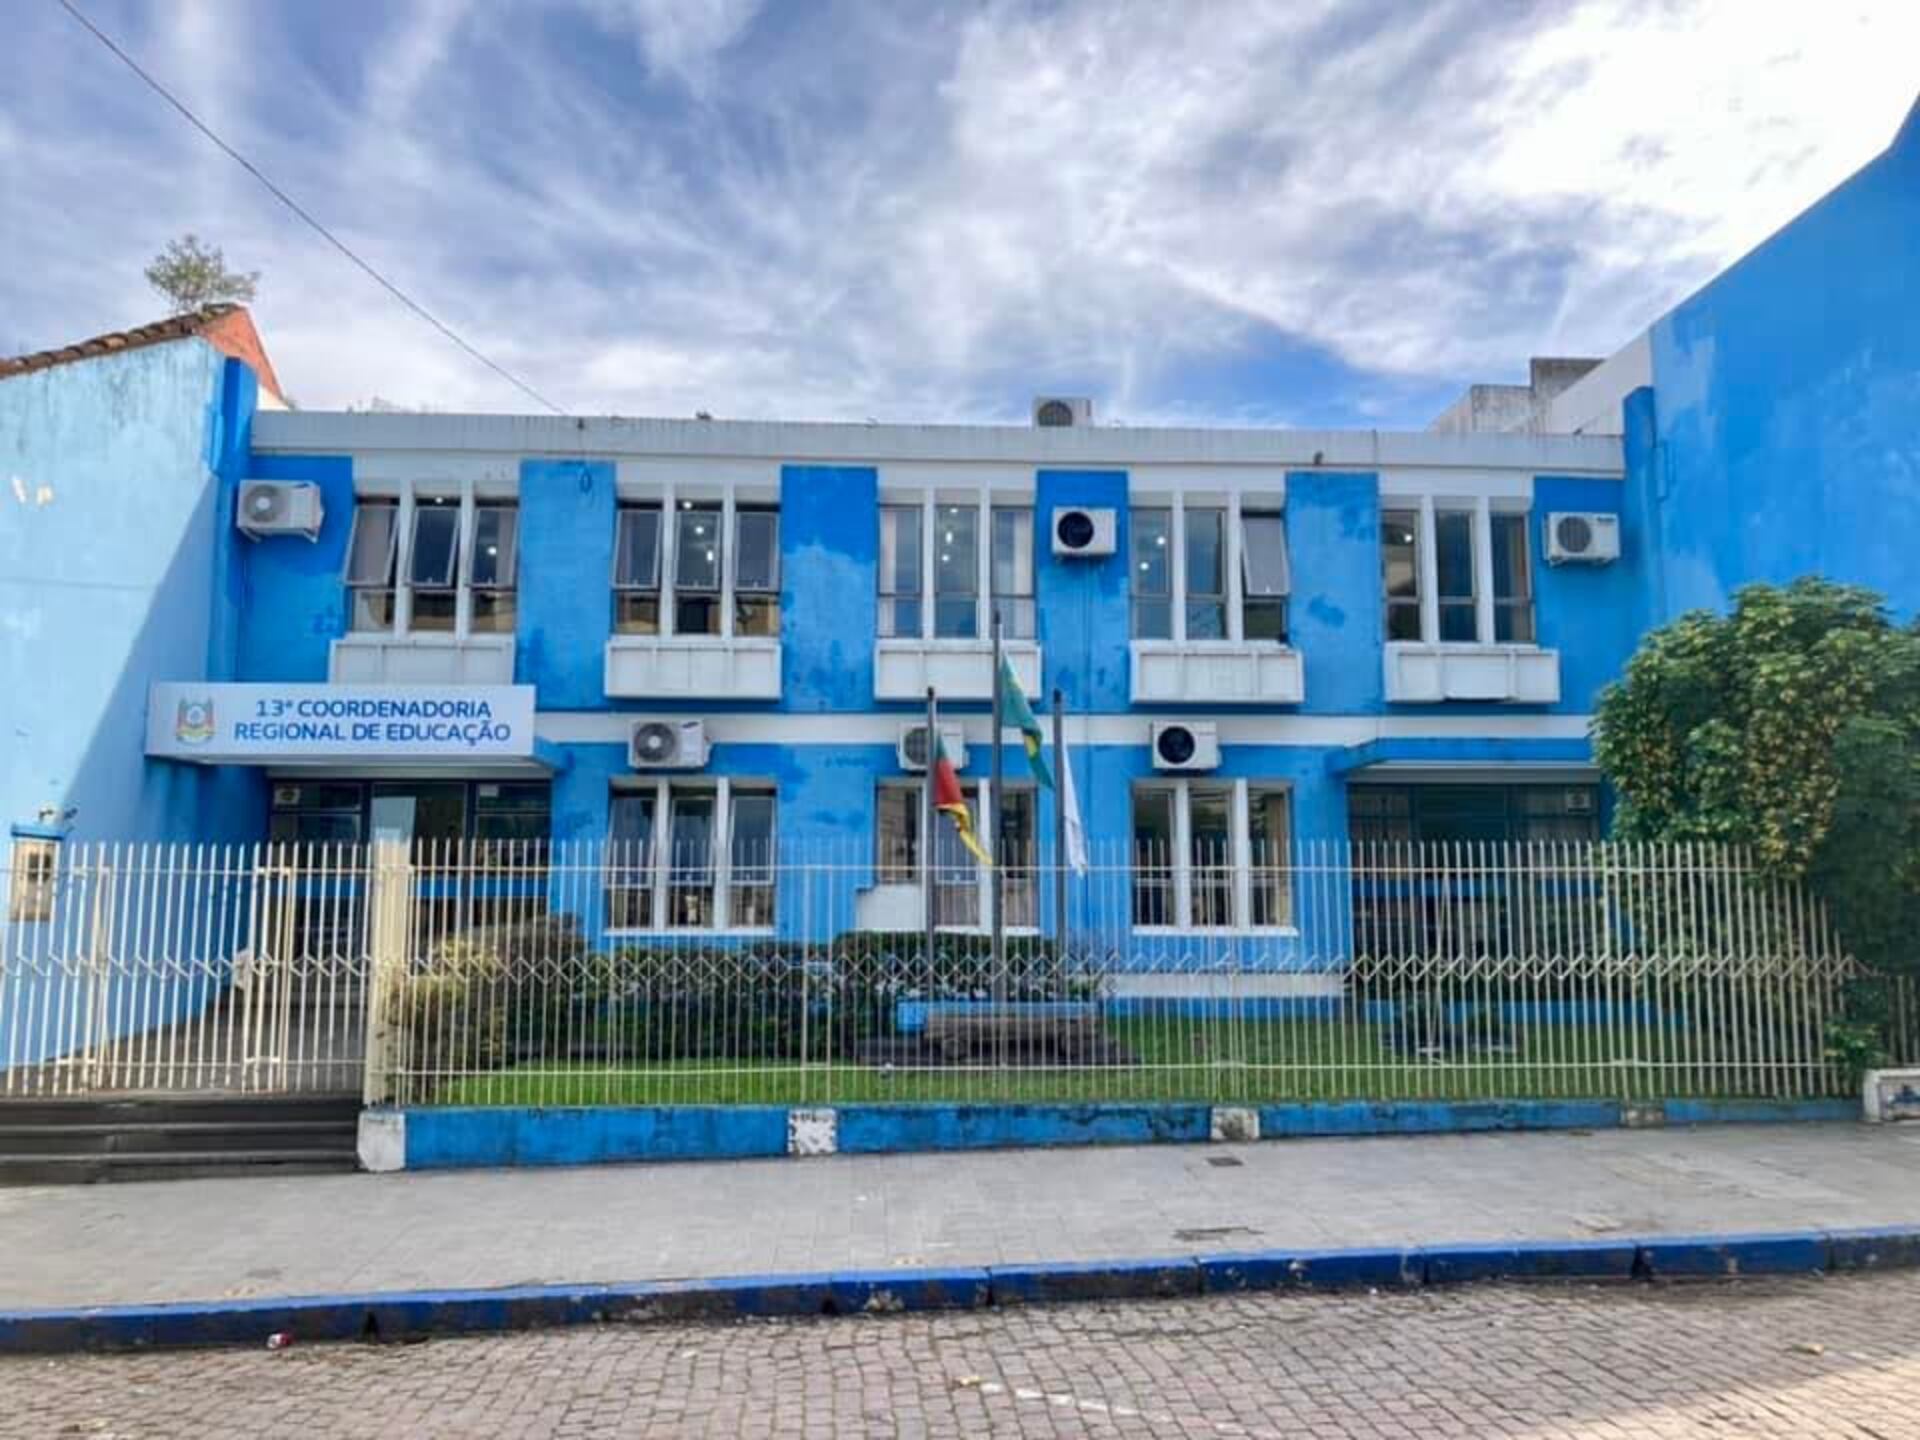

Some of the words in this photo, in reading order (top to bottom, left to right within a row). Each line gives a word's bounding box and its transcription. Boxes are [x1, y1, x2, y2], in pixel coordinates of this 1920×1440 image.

[297, 699, 491, 718] COORDENADORIA
[234, 722, 346, 740] REGIONAL
[351, 723, 380, 740] DE
[385, 720, 510, 746] EDUCAÇÃO
